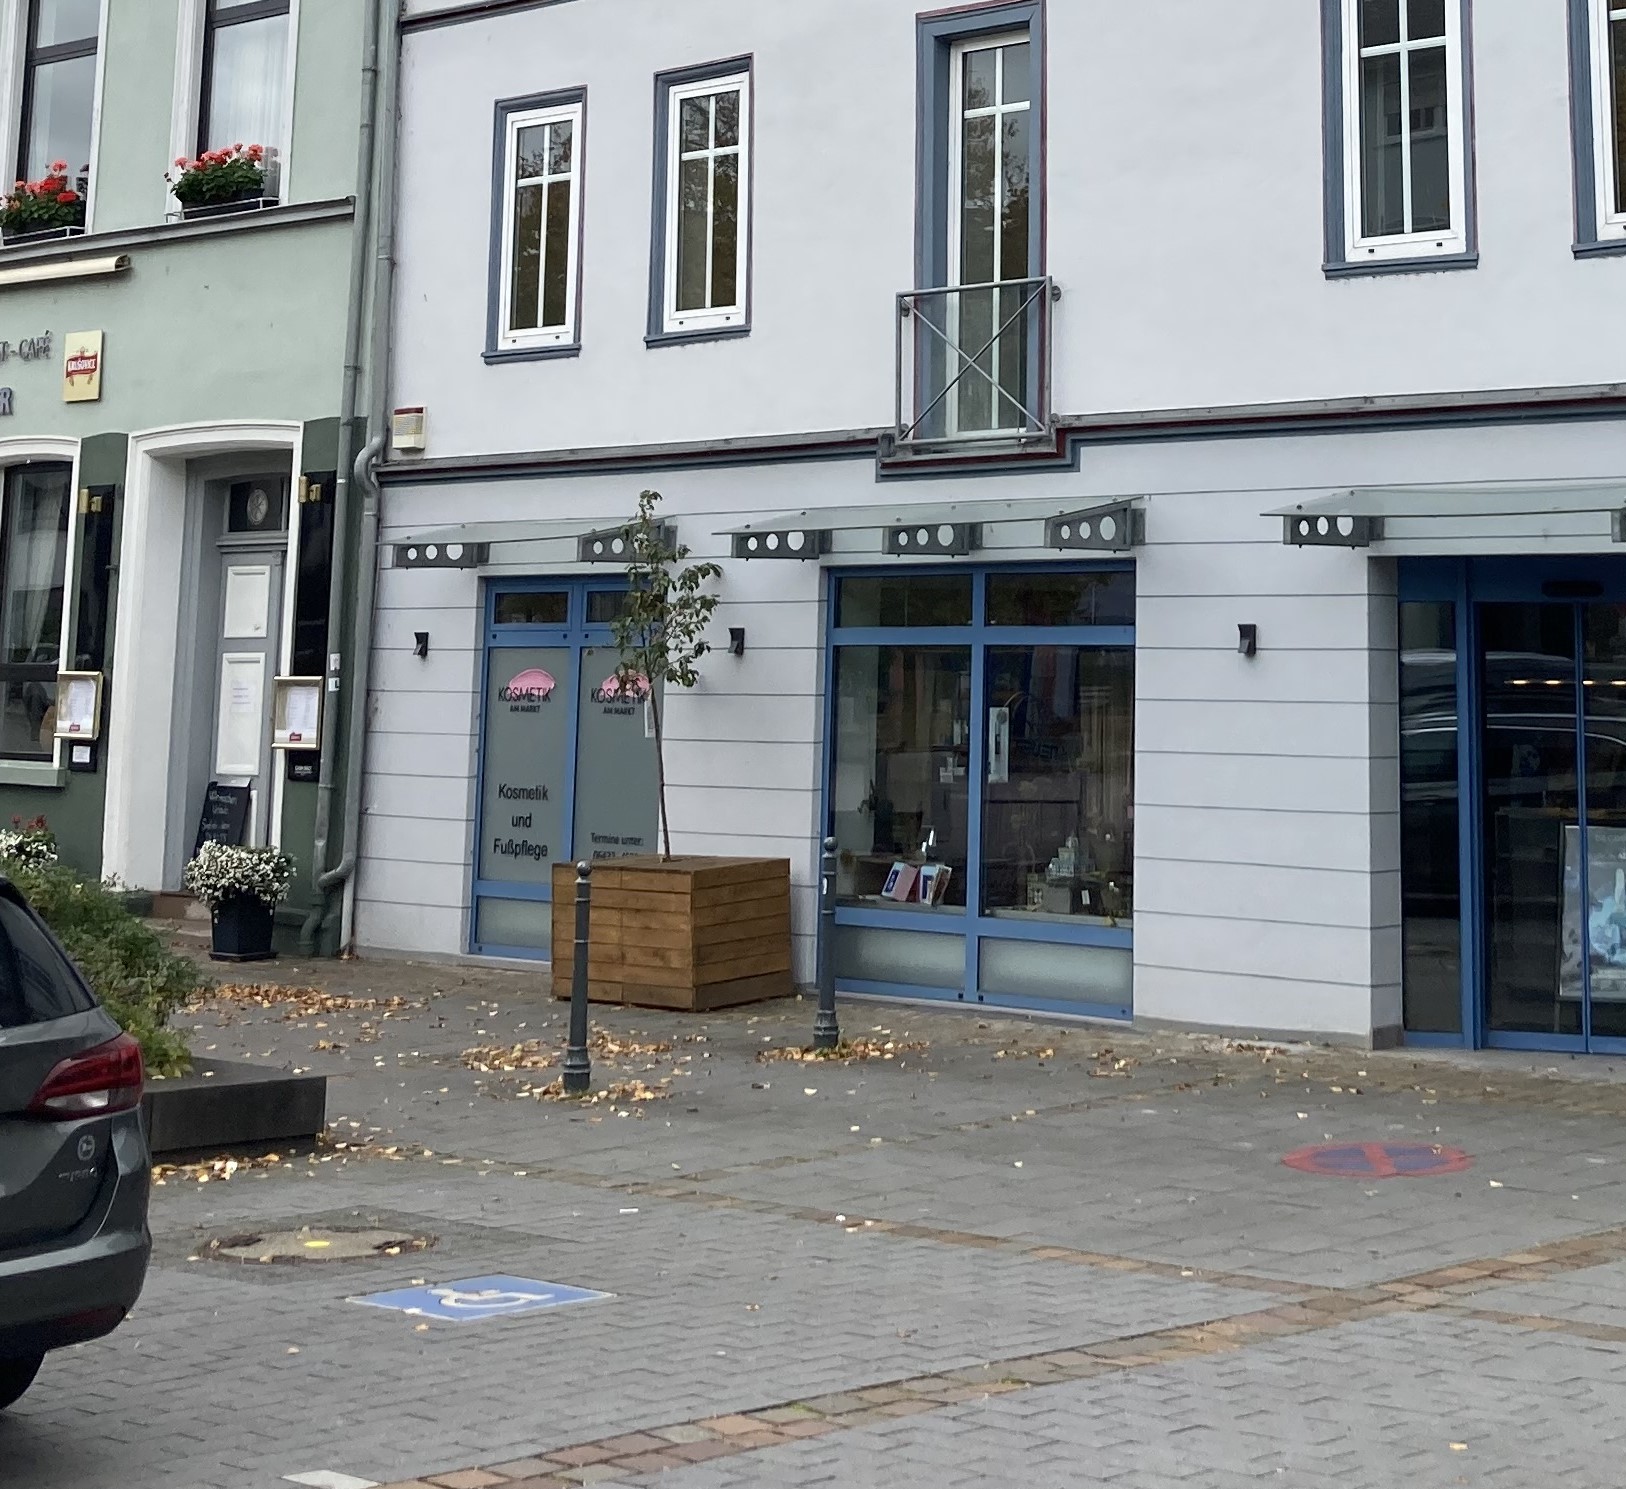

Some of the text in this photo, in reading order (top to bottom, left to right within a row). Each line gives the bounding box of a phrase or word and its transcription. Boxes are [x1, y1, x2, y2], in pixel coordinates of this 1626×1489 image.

[498, 687, 552, 703] KOSMETIK
[498, 783, 549, 801] Kosmetik
[511, 813, 532, 828] und
[591, 832, 620, 845] Termine
[493, 838, 549, 861] Fußpflege
